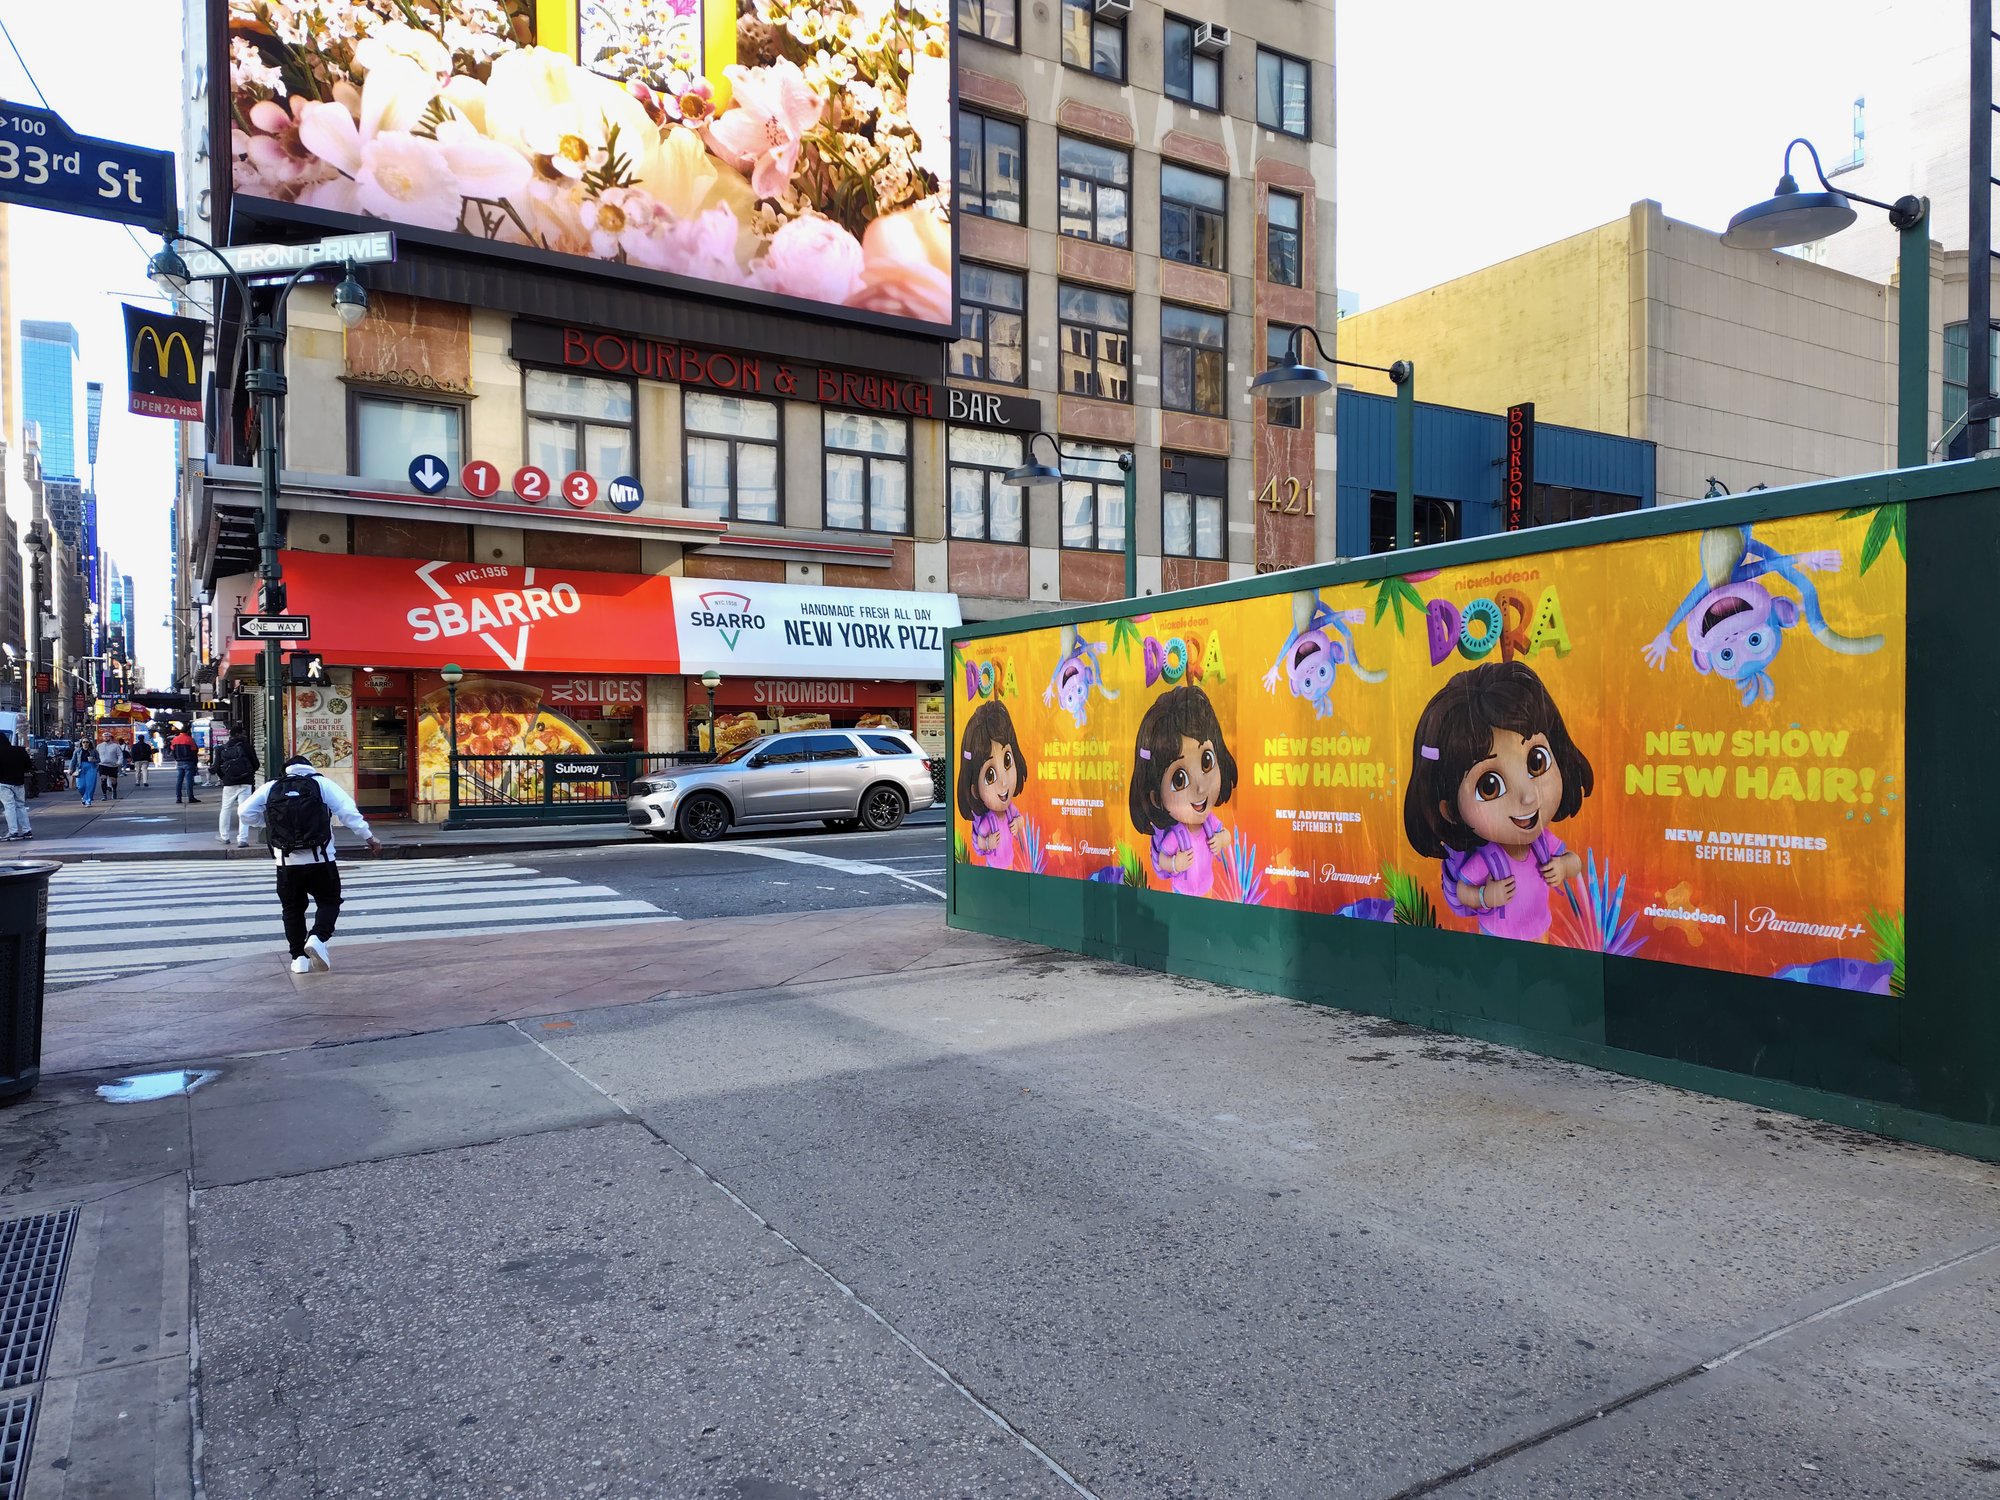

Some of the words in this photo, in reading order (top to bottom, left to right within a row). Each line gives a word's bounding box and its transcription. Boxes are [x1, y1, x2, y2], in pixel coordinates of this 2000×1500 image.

[11, 117, 46, 137] 100
[97, 161, 143, 204] St
[308, 237, 388, 264] PRIME
[563, 327, 761, 392] BOURBON
[774, 365, 798, 395] &
[817, 369, 933, 417] BRANCH
[949, 390, 1011, 424] BAR
[133, 399, 161, 413] OPEN
[163, 403, 176, 414] 24
[180, 405, 198, 417] HRS
[1509, 407, 1523, 511] BOURBON
[473, 466, 486, 492] 1
[523, 472, 541, 497] 2
[571, 477, 589, 501] 3
[610, 482, 639, 504] MTA
[1258, 475, 1317, 518] 421
[455, 566, 508, 585] NYC.1956
[1454, 568, 1540, 591] nickelodeon
[407, 582, 582, 642] SBARRO
[690, 611, 766, 629] SBARRO
[801, 603, 855, 618] HANDMADE
[860, 606, 890, 619] FRESH
[894, 608, 911, 620] ALL
[915, 609, 931, 621] DAY
[249, 622, 268, 631] ONE
[277, 623, 298, 631] WAY
[784, 619, 832, 647] NEW
[838, 622, 895, 650] YORK
[897, 625, 943, 651] PIZZ
[1160, 617, 1209, 631] nickelodeon
[1425, 584, 1572, 667] DORA
[1143, 629, 1226, 688] DORA
[965, 655, 1018, 701] DORA
[552, 680, 573, 701] XL
[575, 680, 642, 702] SLICES
[754, 680, 854, 704] STROMBOLI
[1044, 741, 1070, 757] NEW
[1073, 740, 1112, 757] SHOW
[1264, 737, 1308, 757] NEW
[1311, 735, 1372, 757] SHOW
[1645, 730, 1726, 757] NEW
[1732, 729, 1850, 758] SHOW
[555, 763, 600, 775] Subway
[1037, 761, 1073, 781] NEW
[1074, 760, 1120, 781] HAIR!
[1254, 763, 1309, 787] NEW
[1314, 762, 1386, 788] HAIR!
[1624, 764, 1728, 798] NEW
[1735, 765, 1876, 804] HAIR!
[1051, 798, 1067, 806] NEW
[1067, 799, 1104, 808] ADVENTURES
[1061, 806, 1085, 817] SEPTEMBER
[1275, 808, 1297, 820] NEW
[1299, 810, 1362, 823] ADVENTURES
[1292, 820, 1332, 833] SEPTEMBER
[1334, 822, 1343, 834] 13
[1045, 842, 1073, 852] nickelodeon
[1078, 839, 1117, 856] Paramount+
[1664, 828, 1704, 843] NEW
[1707, 831, 1827, 851] ADVENTURES
[1695, 845, 1767, 865] SEPTEMBER
[1772, 849, 1791, 866] 13
[1264, 864, 1310, 878] nickelodeon
[1319, 863, 1382, 885] Paramount+
[1643, 905, 1726, 925] nickelodeon
[1744, 905, 1866, 941] Paramount+
